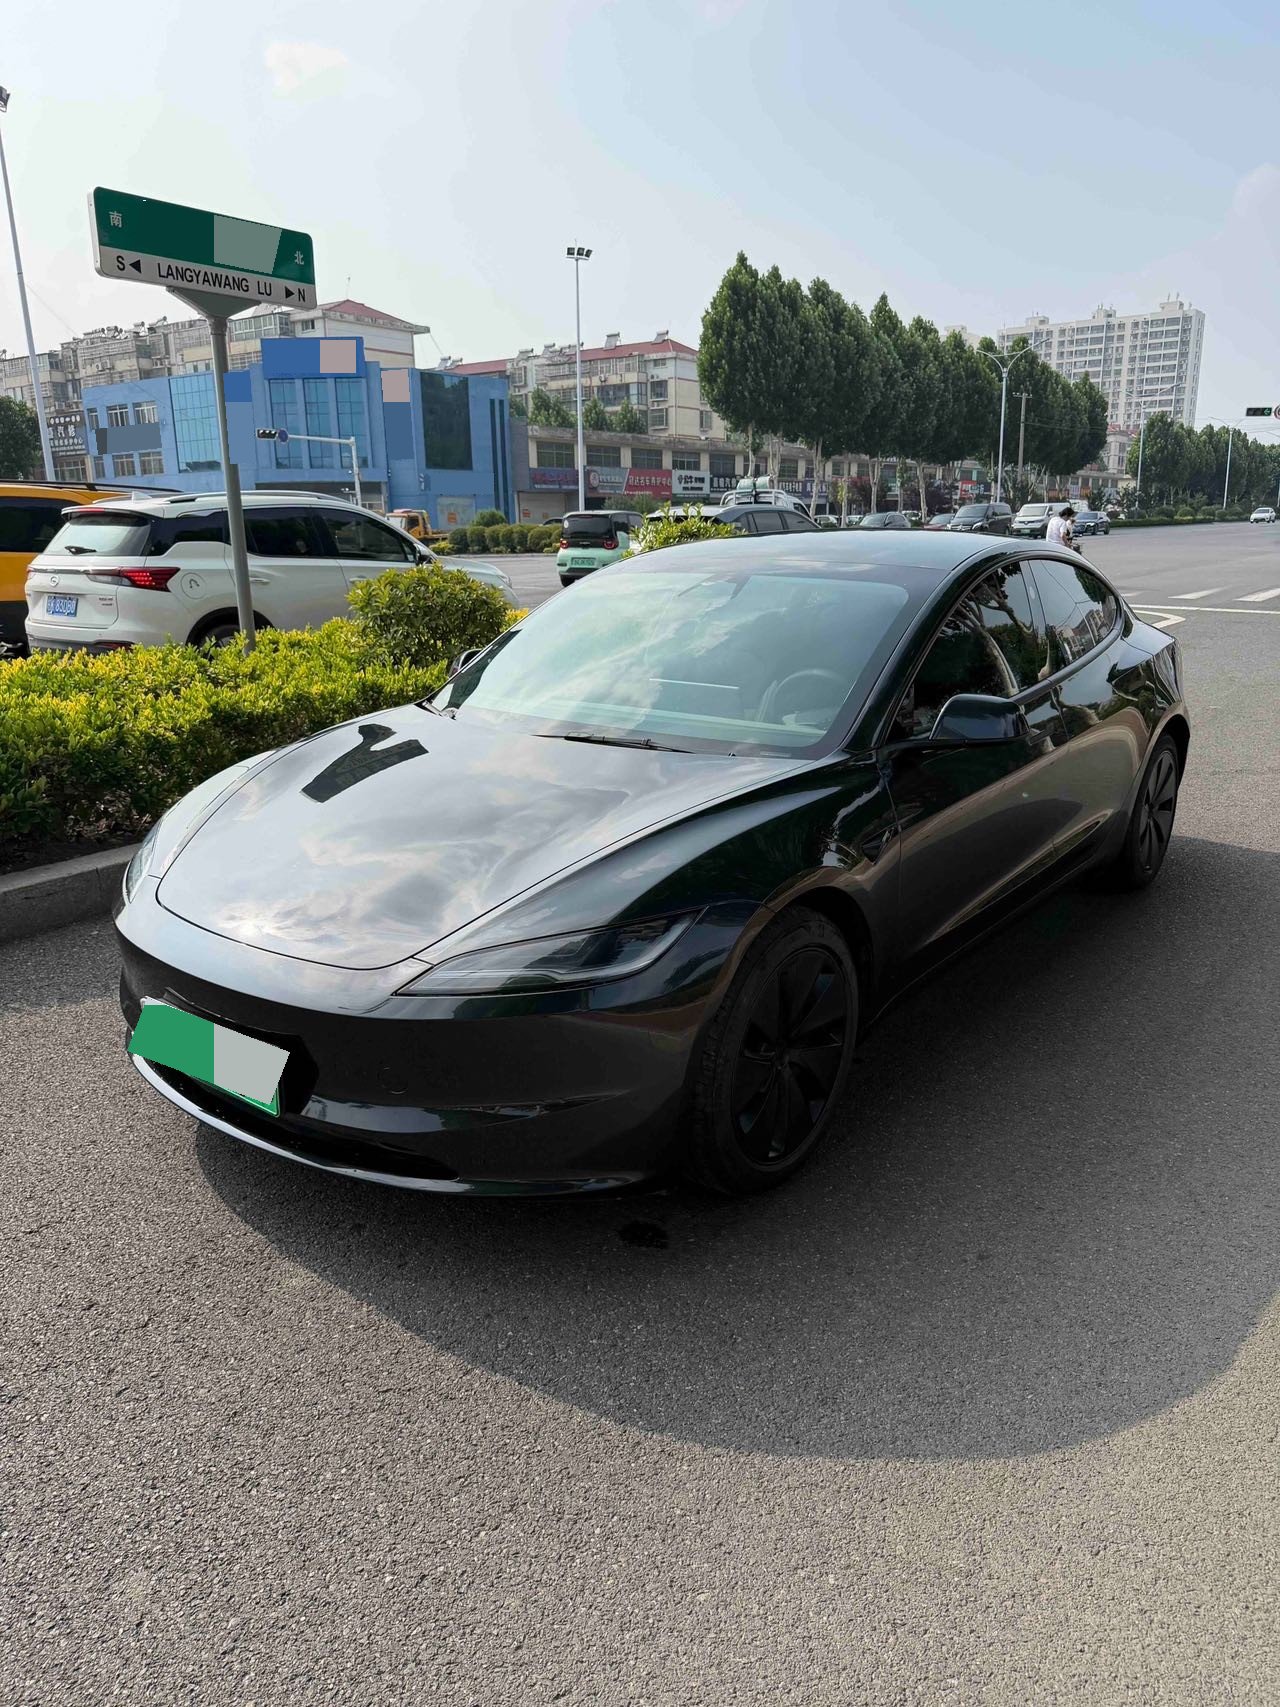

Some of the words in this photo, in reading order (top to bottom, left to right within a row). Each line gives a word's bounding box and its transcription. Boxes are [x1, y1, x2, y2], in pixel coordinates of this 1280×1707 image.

[109, 211, 123, 228] 南
[294, 250, 305, 266] 北
[116, 255, 126, 271] S
[158, 262, 249, 293] LANGYAWANG
[257, 281, 272, 297] LU
[297, 288, 306, 302] N
